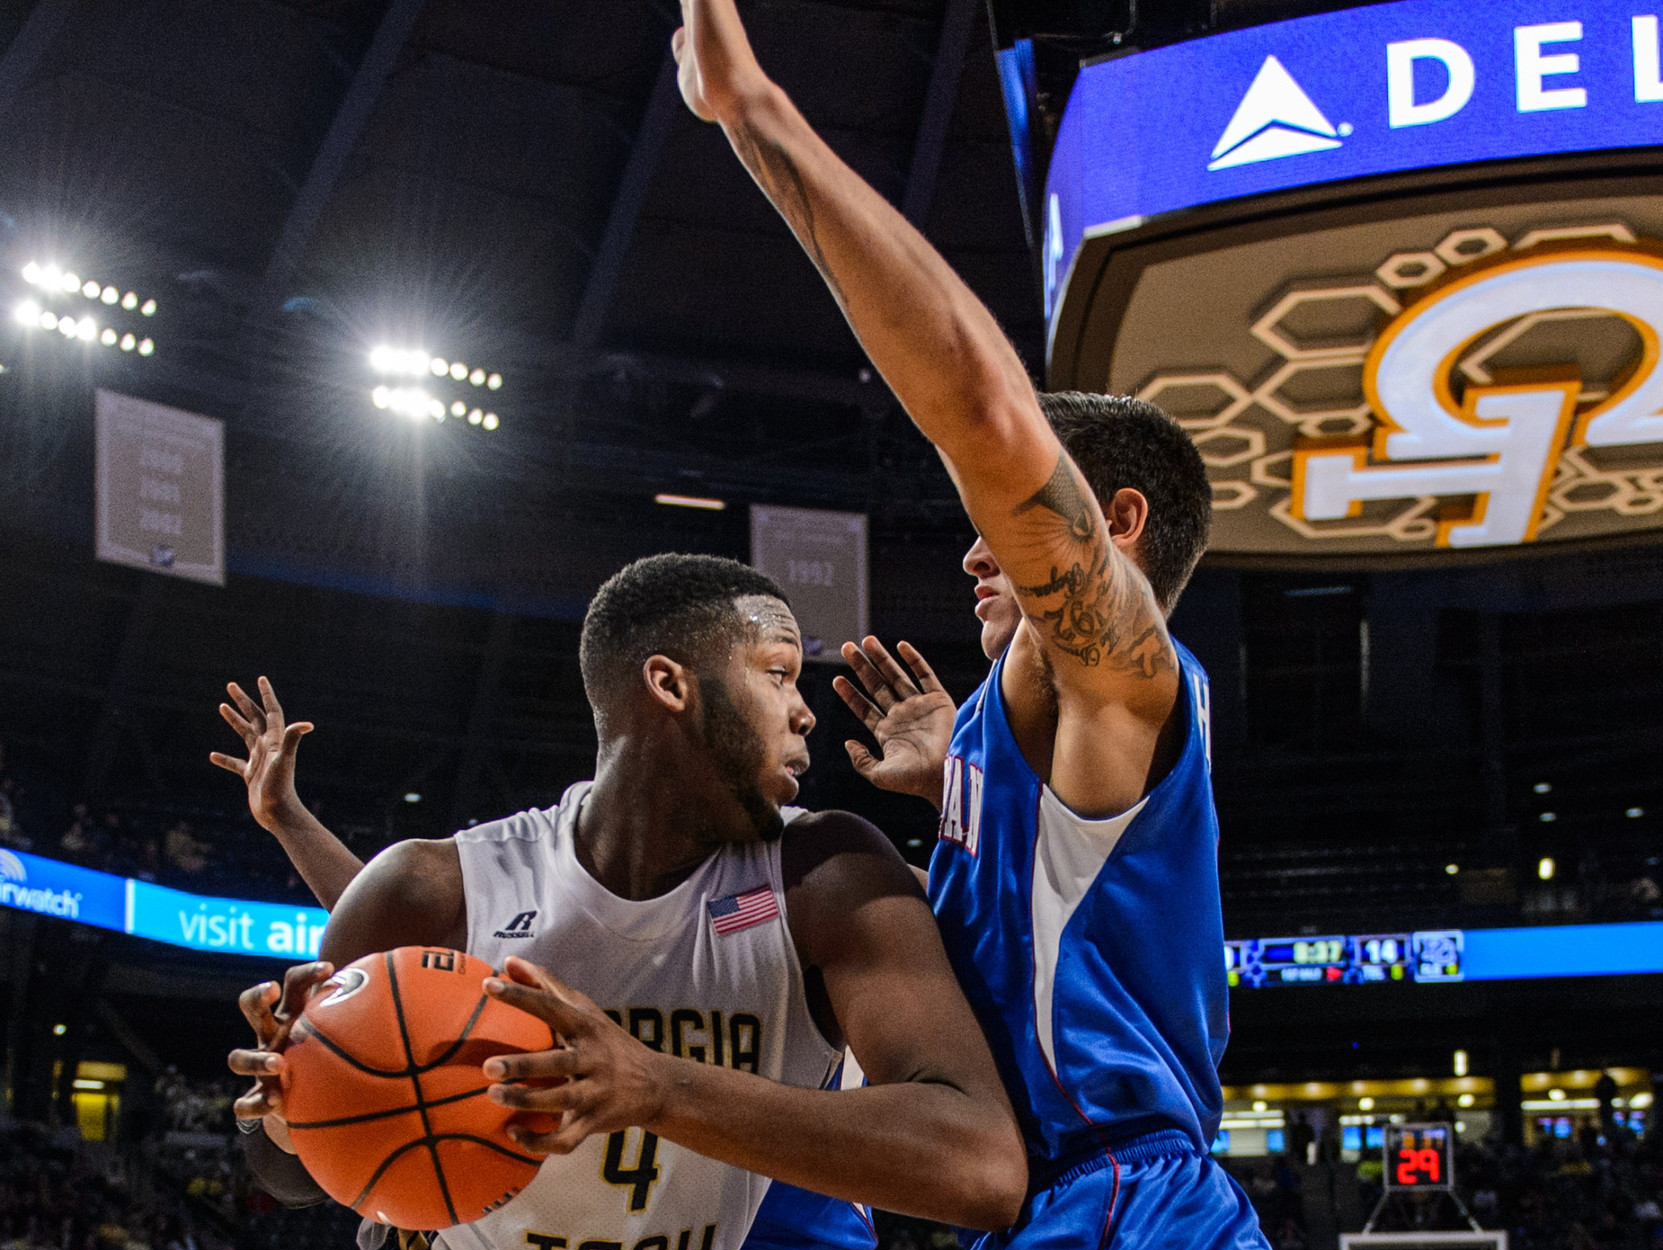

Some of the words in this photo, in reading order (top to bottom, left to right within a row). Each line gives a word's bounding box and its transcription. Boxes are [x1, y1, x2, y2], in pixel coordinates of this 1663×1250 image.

[178, 902, 254, 949] visit
[1365, 939, 1398, 964] 14
[602, 1126, 661, 1215] 4
